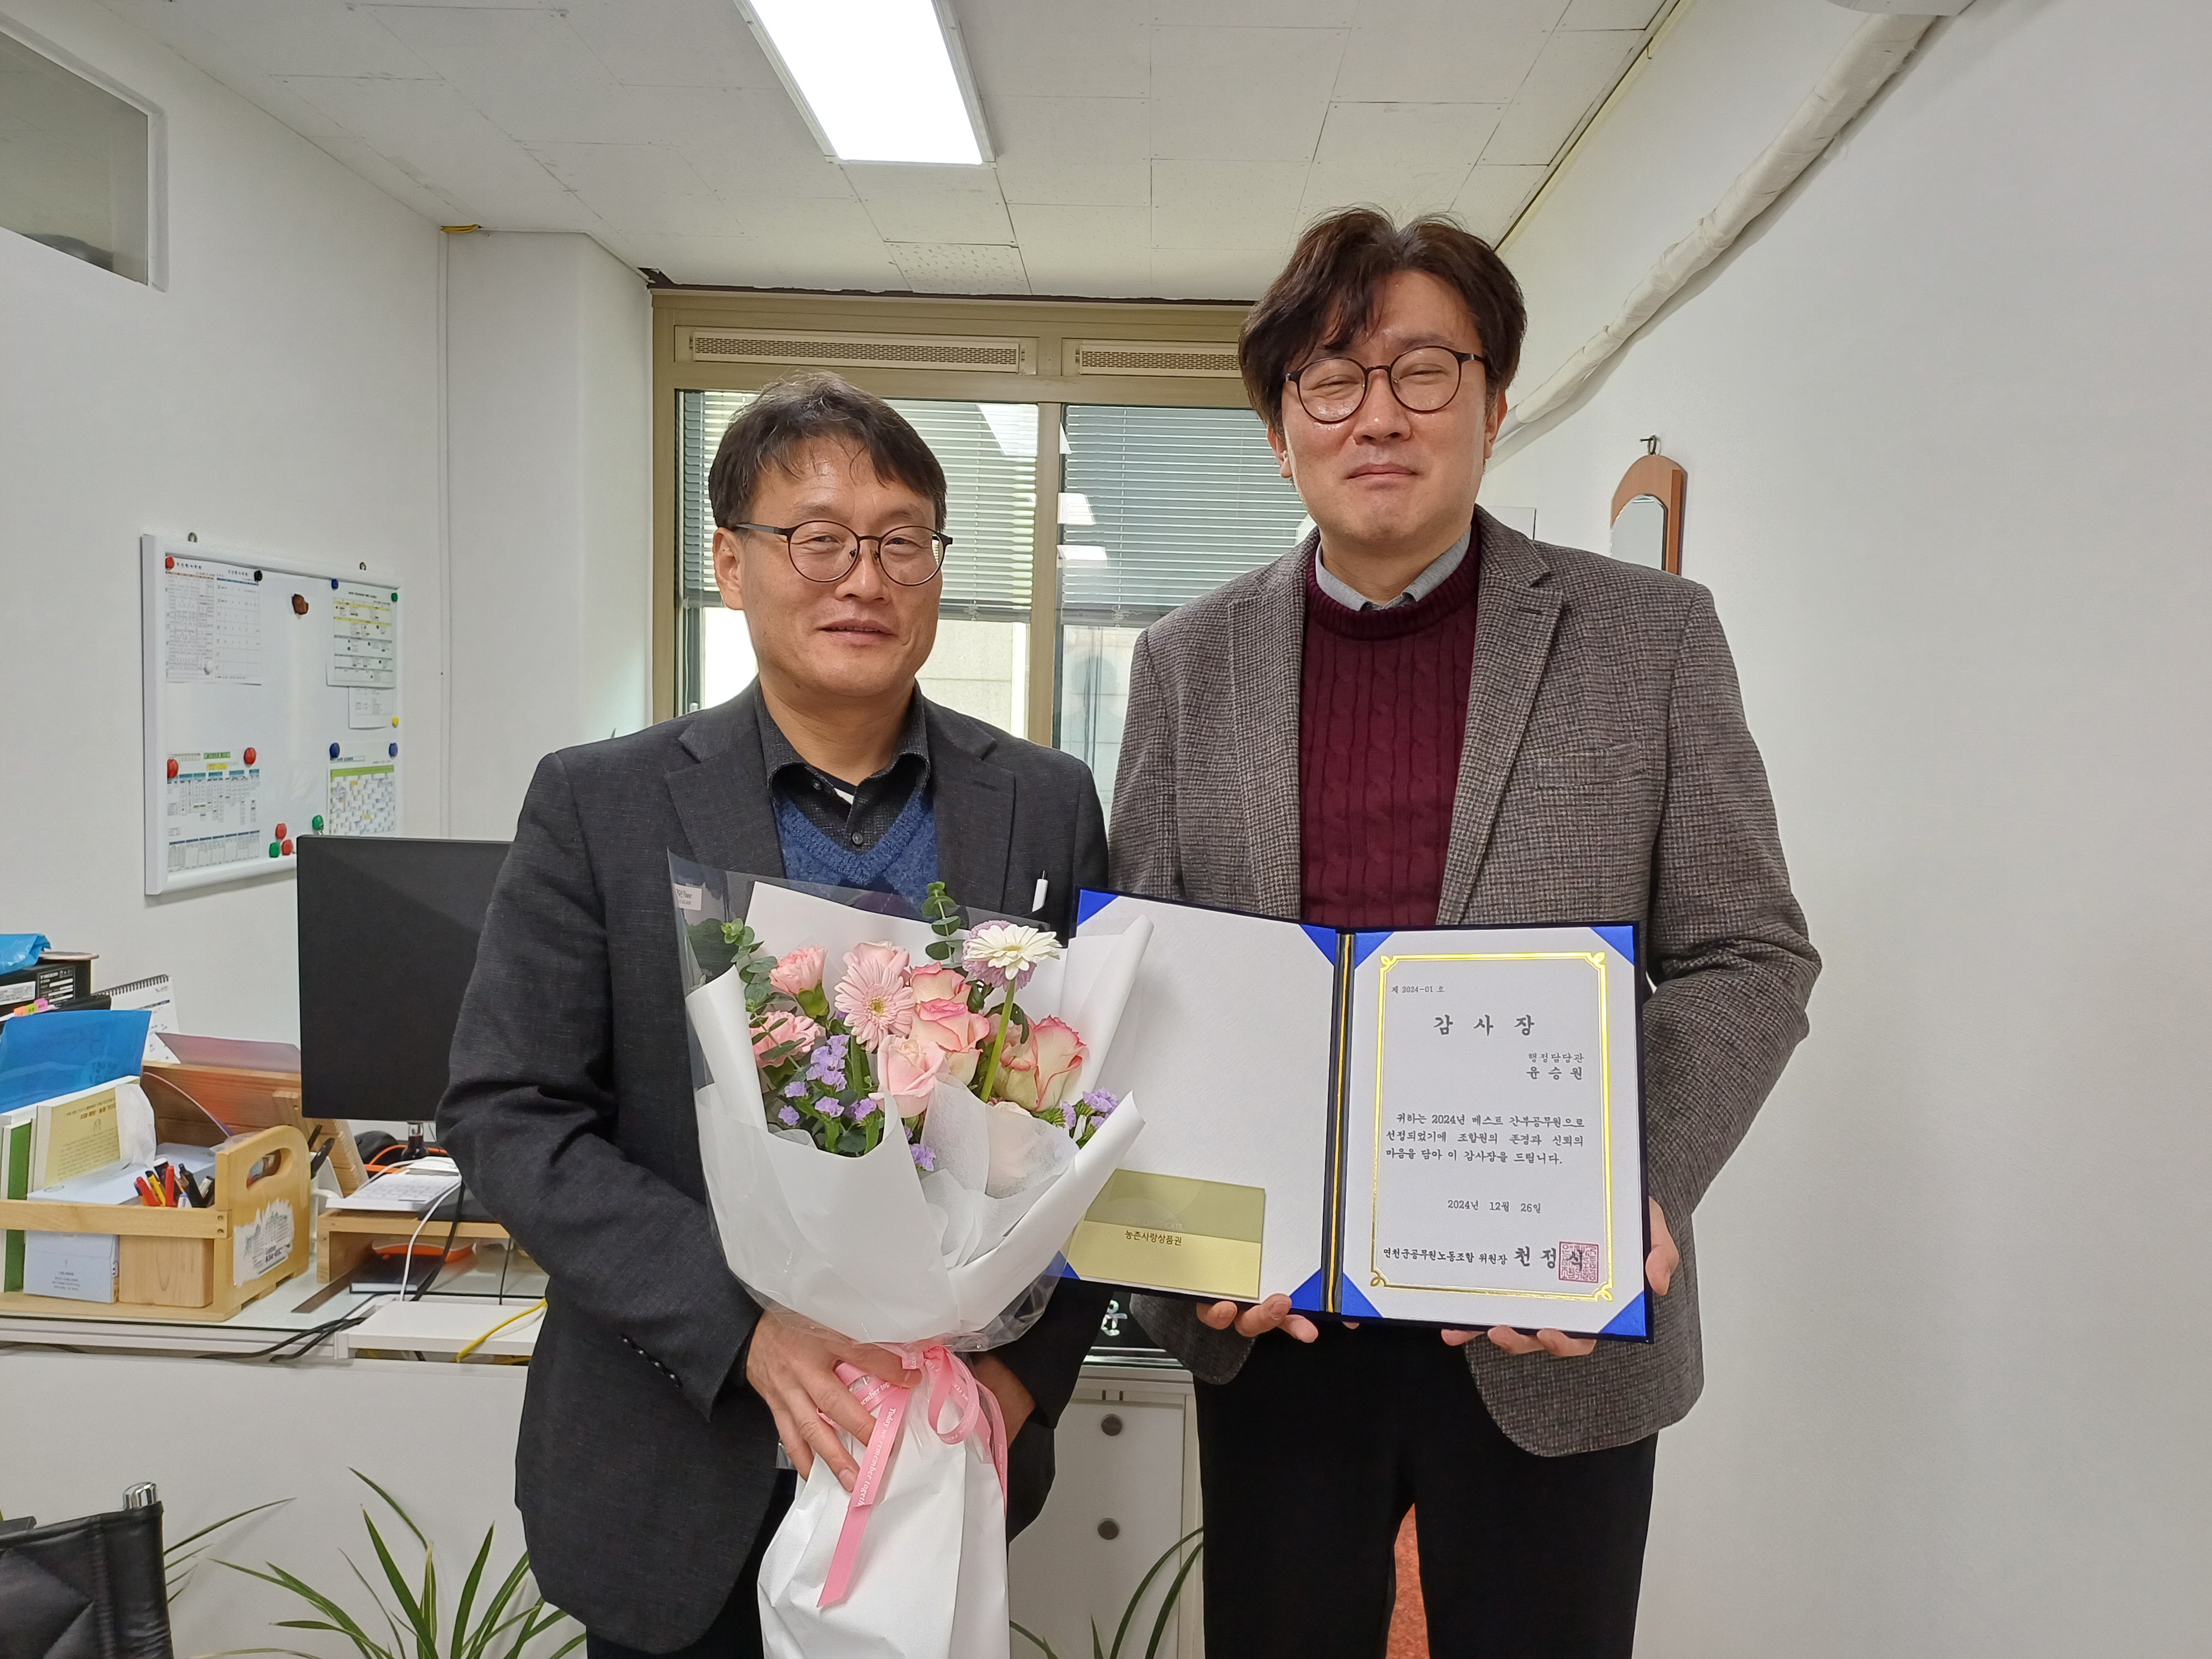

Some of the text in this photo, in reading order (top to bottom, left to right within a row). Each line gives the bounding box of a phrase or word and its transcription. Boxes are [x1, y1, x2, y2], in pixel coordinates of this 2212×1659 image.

[1391, 985, 1399, 994] 제
[1528, 1052, 1584, 1063] 행정담당관
[1396, 1112, 1585, 1128] 귀하는 2024년 베스트 간부공무원으로
[1386, 1129, 1583, 1147] 선정되었기에 조합원의 존경과 신뢰의
[1385, 1147, 1563, 1165] 마음을 담아 이 감사장을 드립니다.
[1448, 1199, 1541, 1214] 2024년 12월 26일
[1125, 1230, 1182, 1246] 농촌사랑상품권
[1383, 1247, 1475, 1263] 연천군공무원노동조합
[1478, 1253, 1508, 1265] 위원장
[860, 1388, 880, 1406] ember
[858, 1407, 896, 1506] Today we remember togeth
